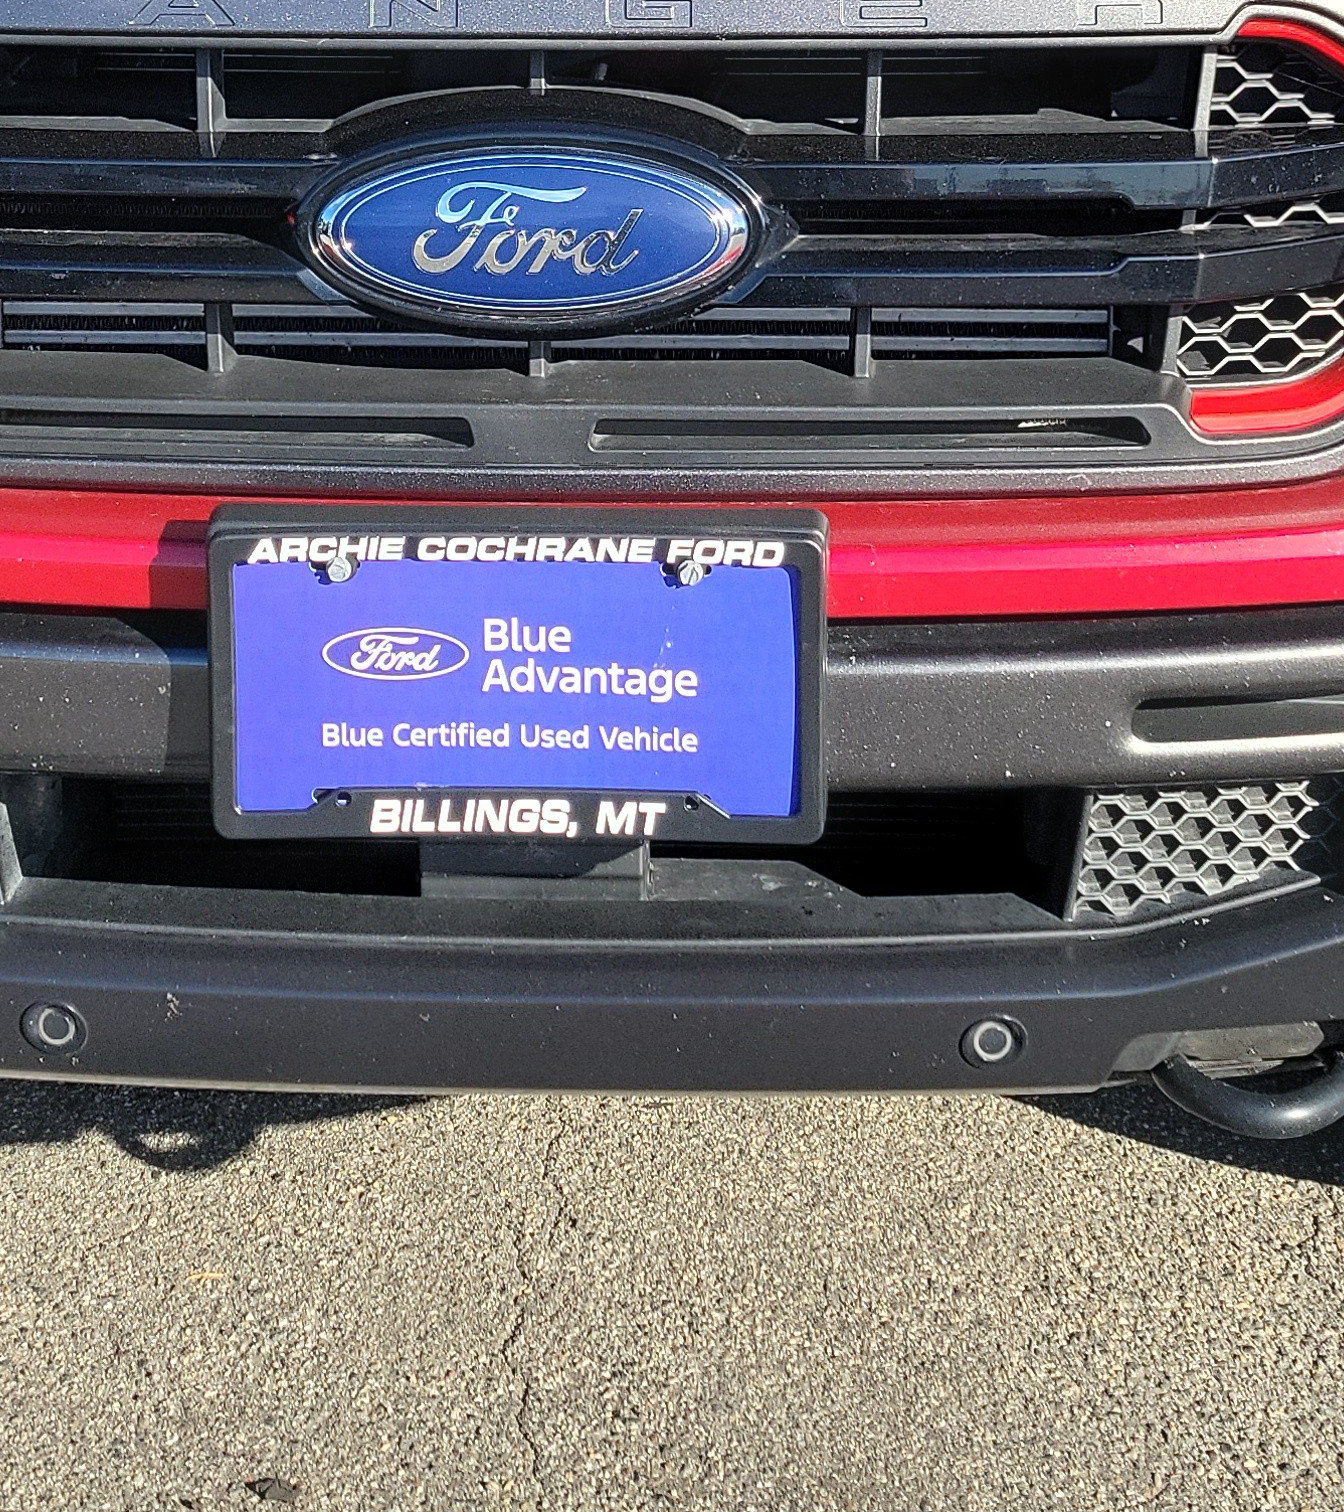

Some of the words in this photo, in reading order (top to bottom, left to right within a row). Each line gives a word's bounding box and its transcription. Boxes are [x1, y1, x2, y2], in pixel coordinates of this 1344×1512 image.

[412, 180, 644, 276] Ford
[247, 536, 406, 564] ARCHIE
[417, 536, 657, 563] COCHRANE
[666, 539, 785, 568] FORD
[350, 634, 440, 672] Ford
[482, 616, 573, 653] Blue
[481, 657, 699, 703] Advantage
[321, 722, 384, 748] Blue
[392, 721, 510, 748] Certified
[519, 723, 590, 750] Used
[598, 725, 699, 753] Vehicle
[369, 798, 579, 838] BILLINGS,
[595, 800, 667, 836] MT
